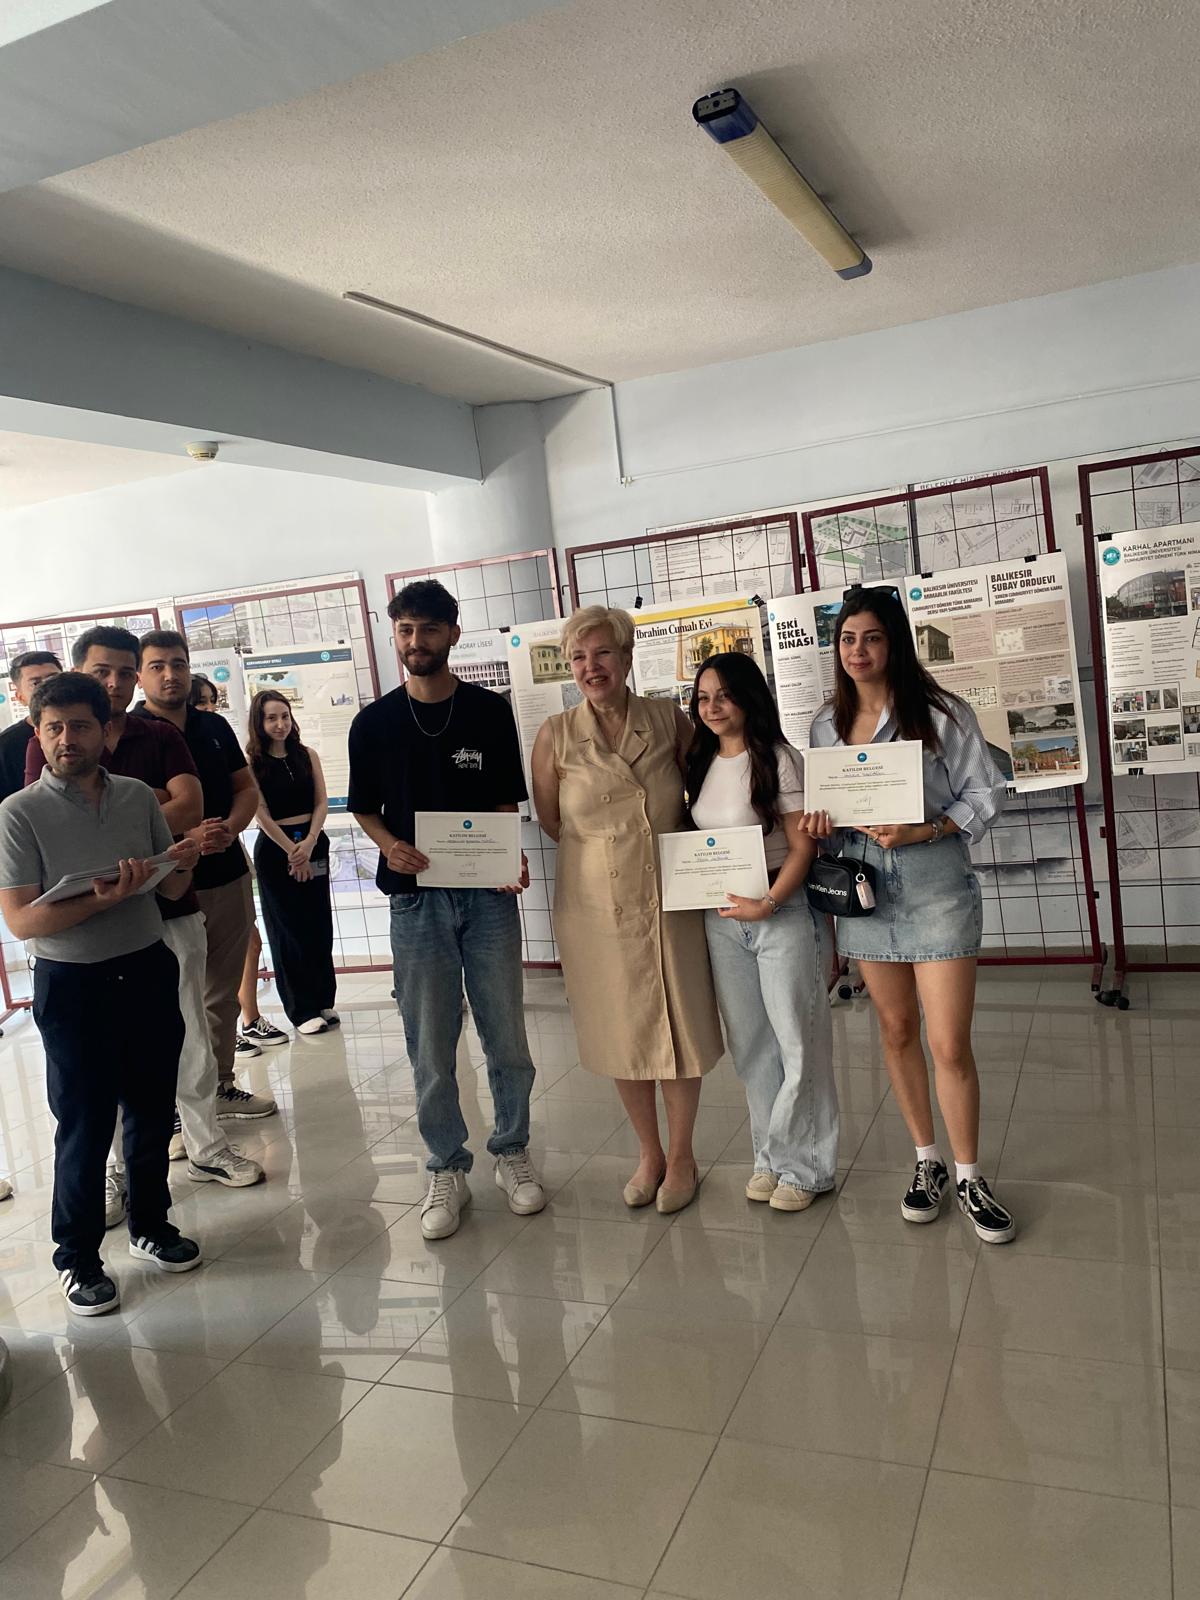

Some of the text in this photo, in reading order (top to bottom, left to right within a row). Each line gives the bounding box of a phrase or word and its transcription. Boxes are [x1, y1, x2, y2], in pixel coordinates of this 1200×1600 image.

[1122, 537, 1195, 552] KARHAL APARTMANI
[990, 569, 1032, 583] BALIKESIR
[991, 574, 1056, 593] SUBAY ORDUEVI
[635, 618, 713, 640] İbrahim Cumalı Evi
[776, 617, 798, 631] ESKİ
[777, 628, 807, 641] TEKEL
[778, 636, 814, 650] BİNASI
[827, 887, 848, 897] Jeans
